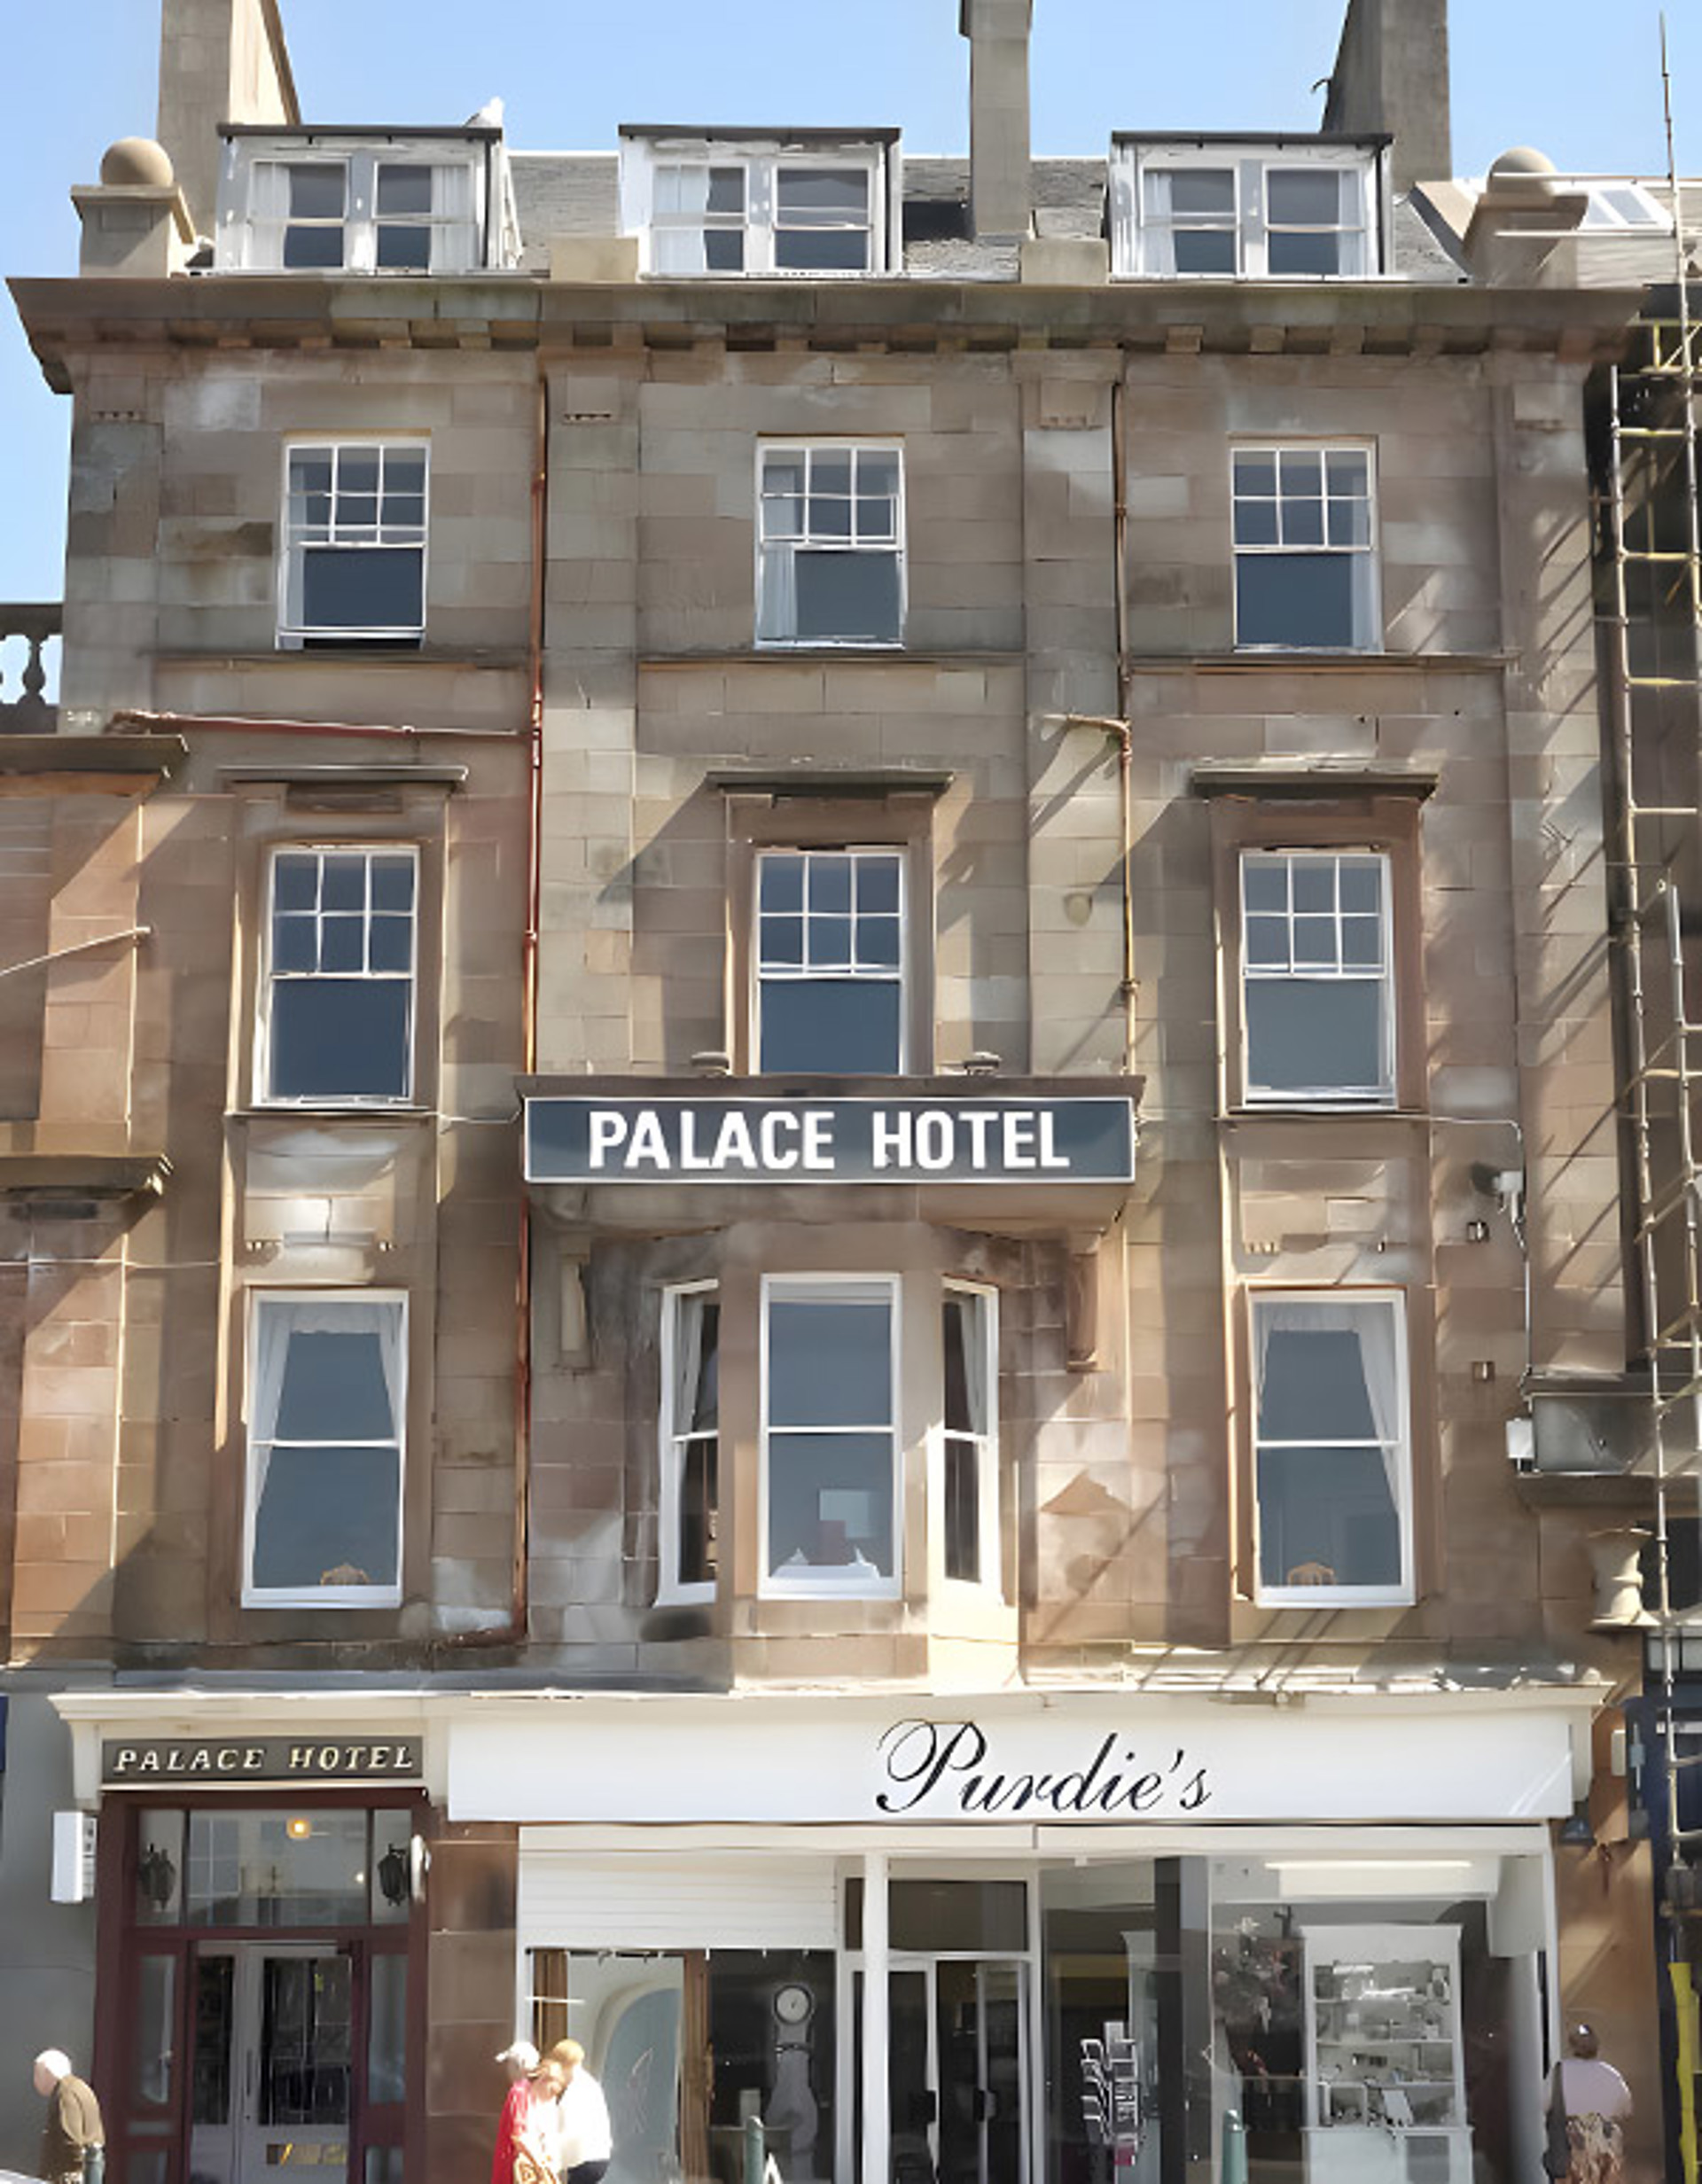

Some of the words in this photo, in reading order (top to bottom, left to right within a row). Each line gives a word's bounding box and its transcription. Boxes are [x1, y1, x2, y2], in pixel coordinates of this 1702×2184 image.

[589, 1110, 835, 1169] PALACE
[872, 1110, 1070, 1170] HOTEL
[113, 1749, 264, 1773] PALACE
[288, 1746, 414, 1771] HOTEL
[877, 1719, 1213, 1813] Purdie's
